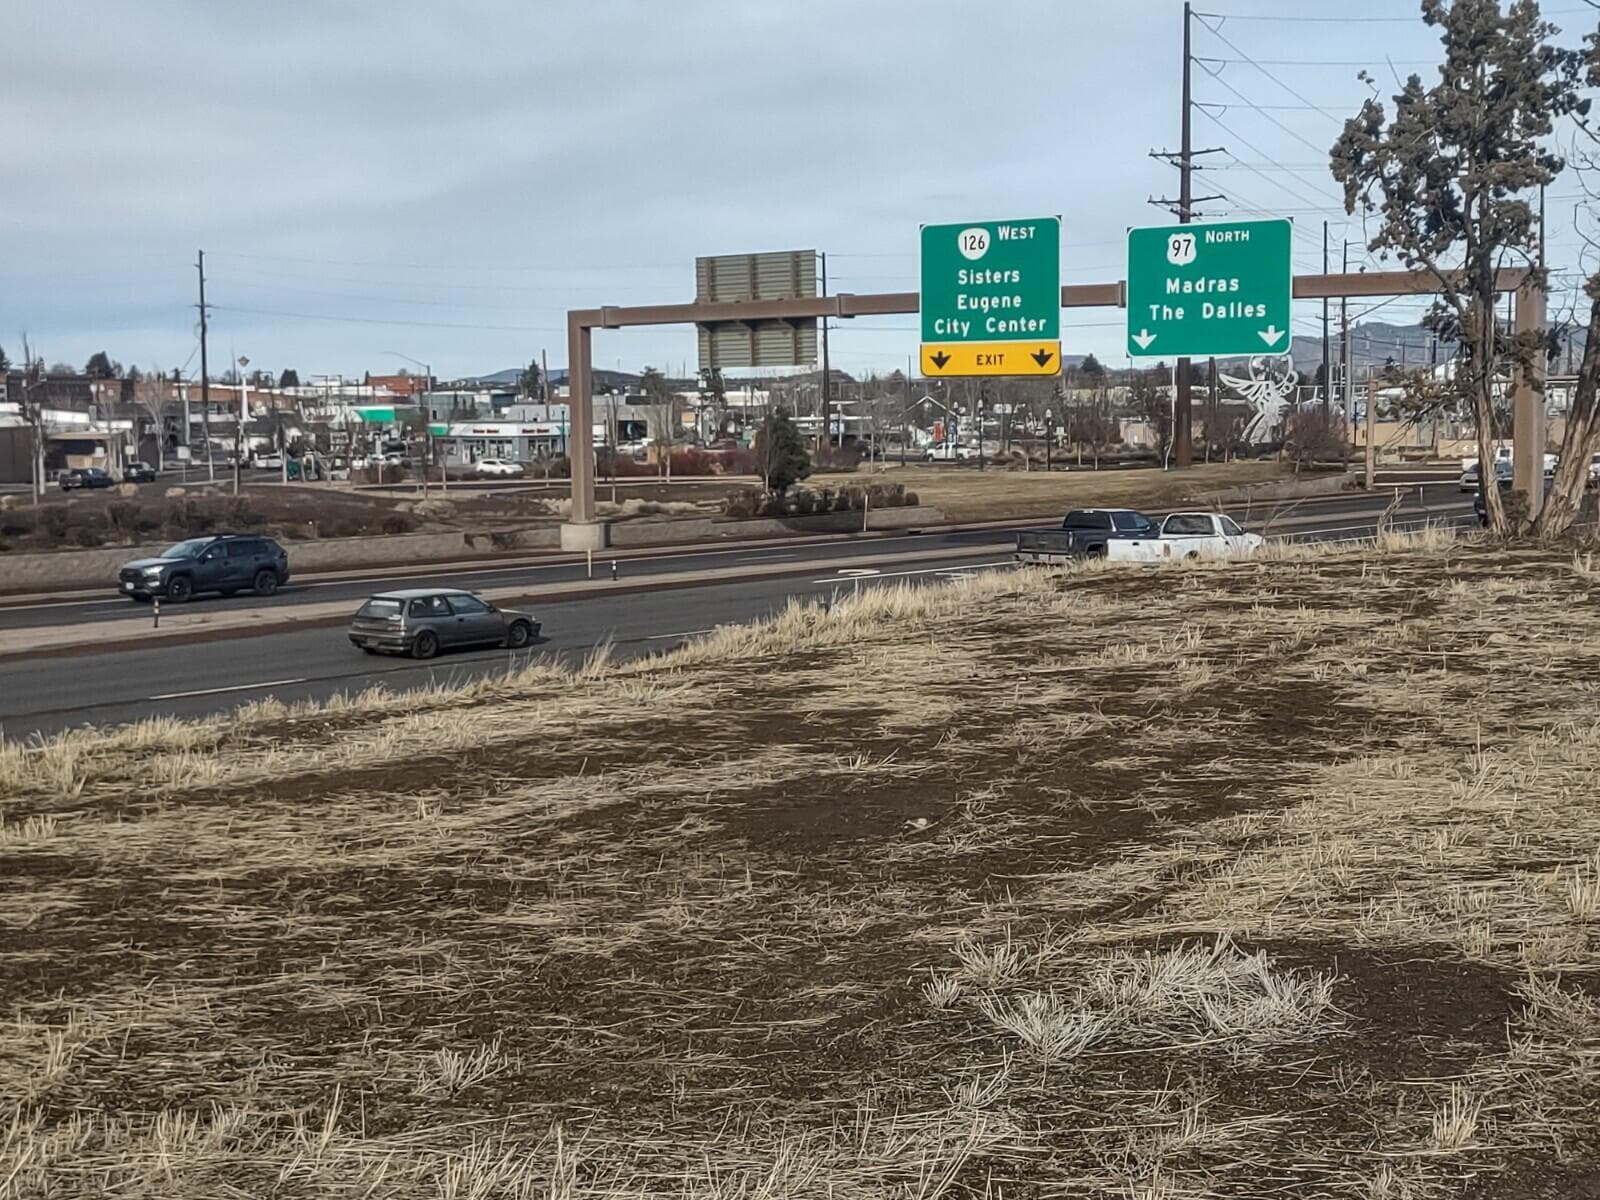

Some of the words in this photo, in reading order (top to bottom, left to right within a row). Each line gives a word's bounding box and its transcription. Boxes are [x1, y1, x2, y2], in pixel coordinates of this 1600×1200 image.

[963, 235, 986, 251] 126
[998, 225, 1036, 241] WEST
[1172, 238, 1192, 257] 97
[1205, 230, 1250, 243] NORTH
[958, 269, 1020, 285] Sisters
[1166, 277, 1239, 294] Madras
[957, 294, 1022, 314] Eugene
[1149, 304, 1185, 321] The
[1202, 302, 1266, 319] Dalles
[934, 318, 970, 337] City
[985, 316, 1046, 333] Center
[976, 354, 1004, 366] EXIT
